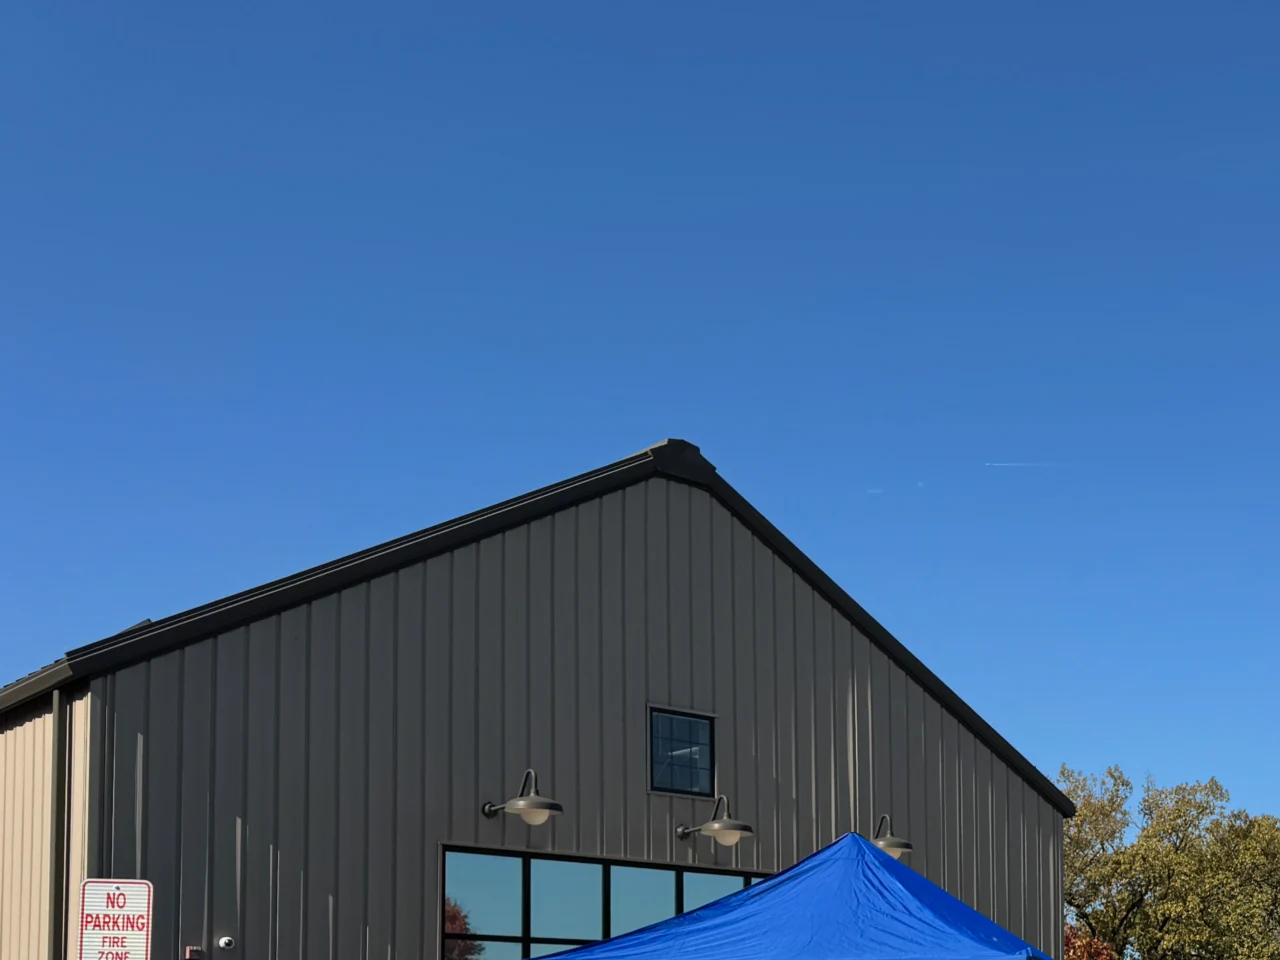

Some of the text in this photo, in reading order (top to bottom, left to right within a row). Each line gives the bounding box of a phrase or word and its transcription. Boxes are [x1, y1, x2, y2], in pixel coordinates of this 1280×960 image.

[106, 892, 126, 909] NO
[85, 913, 146, 931] PARKING
[102, 936, 127, 948] FIRE
